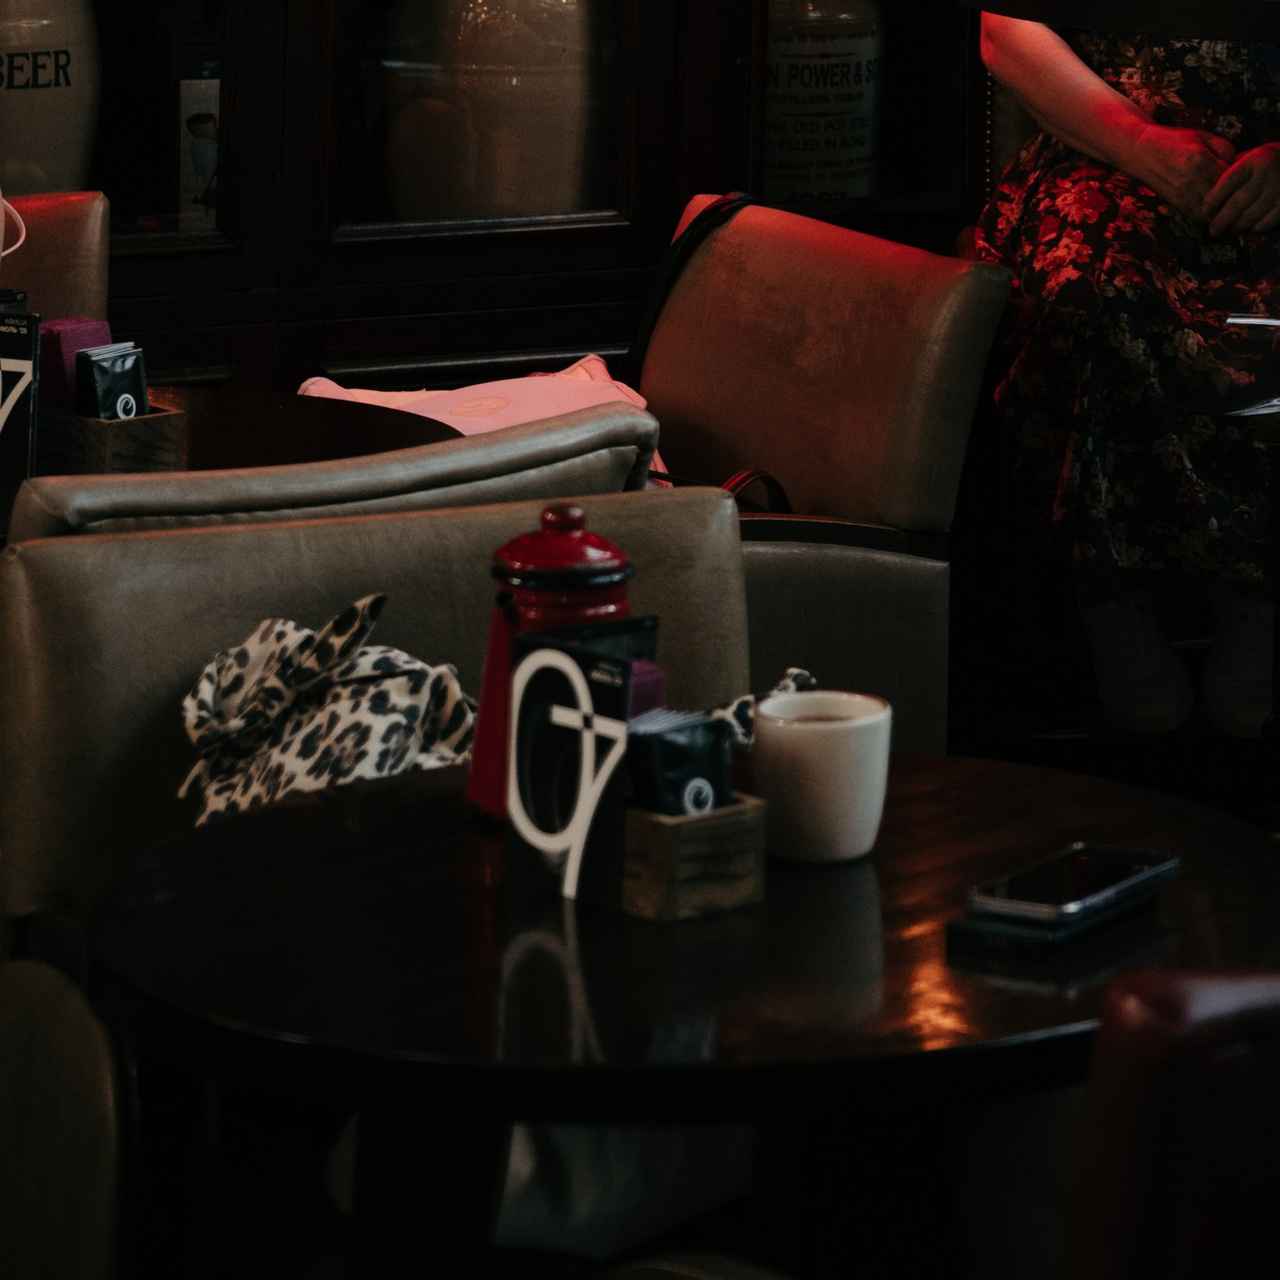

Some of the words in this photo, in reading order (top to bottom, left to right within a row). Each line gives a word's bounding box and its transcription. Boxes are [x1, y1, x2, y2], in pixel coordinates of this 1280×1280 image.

[787, 61, 850, 88] POWER
[853, 60, 862, 85] &
[791, 120, 820, 133] OLD
[824, 119, 846, 133] POT
